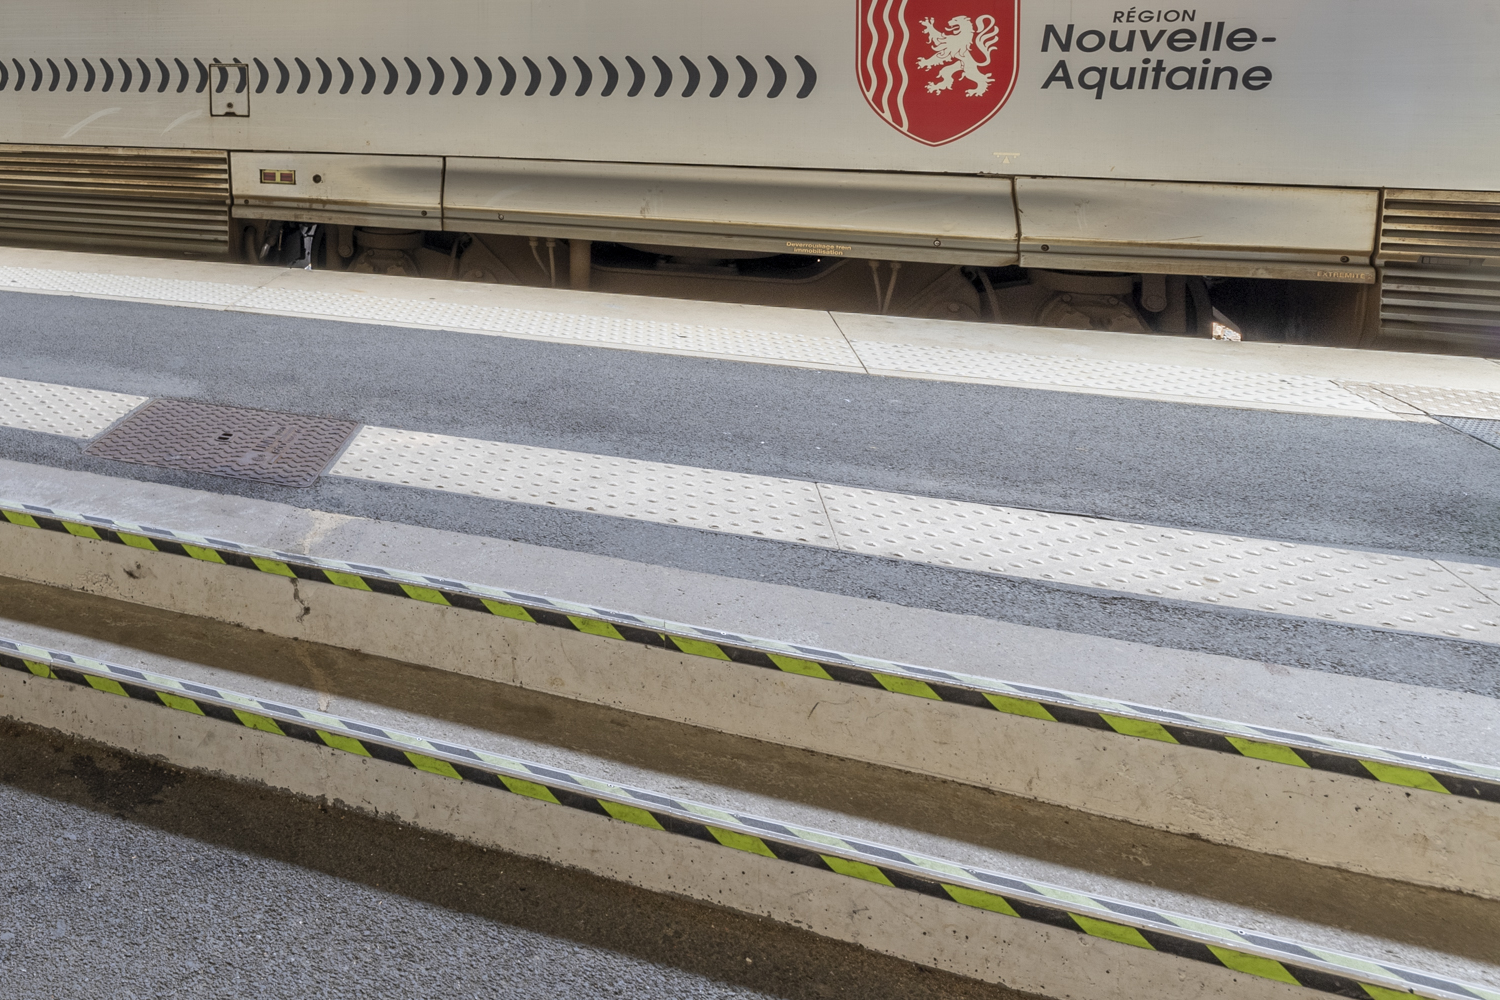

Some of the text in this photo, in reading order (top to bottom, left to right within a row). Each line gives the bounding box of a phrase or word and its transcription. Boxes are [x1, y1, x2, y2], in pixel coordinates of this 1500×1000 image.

[1112, 6, 1197, 24] RÉGION
[1041, 21, 1277, 53] Nouvelle-
[1040, 57, 1273, 100] Aquitaine
